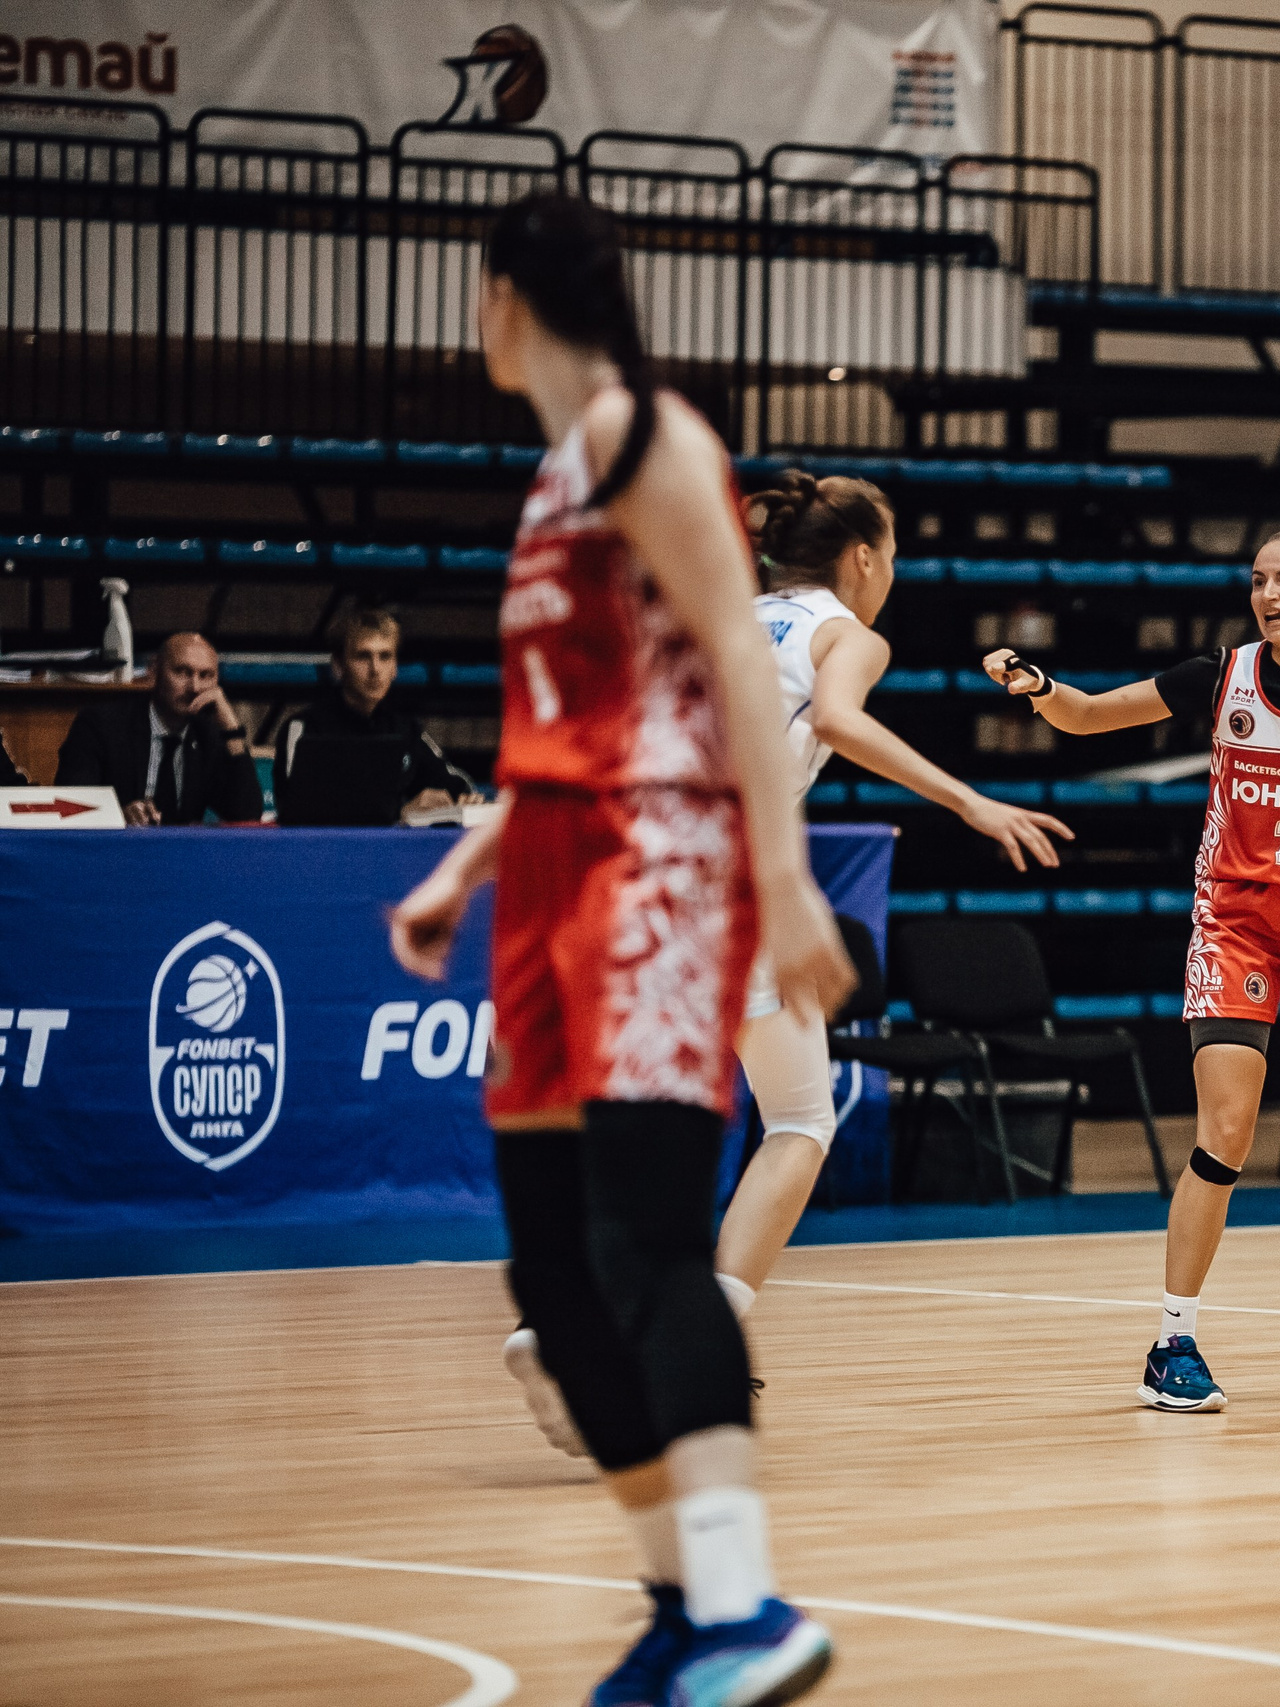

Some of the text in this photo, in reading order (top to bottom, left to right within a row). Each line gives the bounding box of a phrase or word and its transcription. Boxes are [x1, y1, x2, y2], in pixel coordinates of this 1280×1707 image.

[1230, 695, 1257, 705] SPORT
[177, 1037, 257, 1060] FONBET
[173, 1064, 262, 1118] СУПЕР
[190, 1120, 245, 1139] ЛИГА
